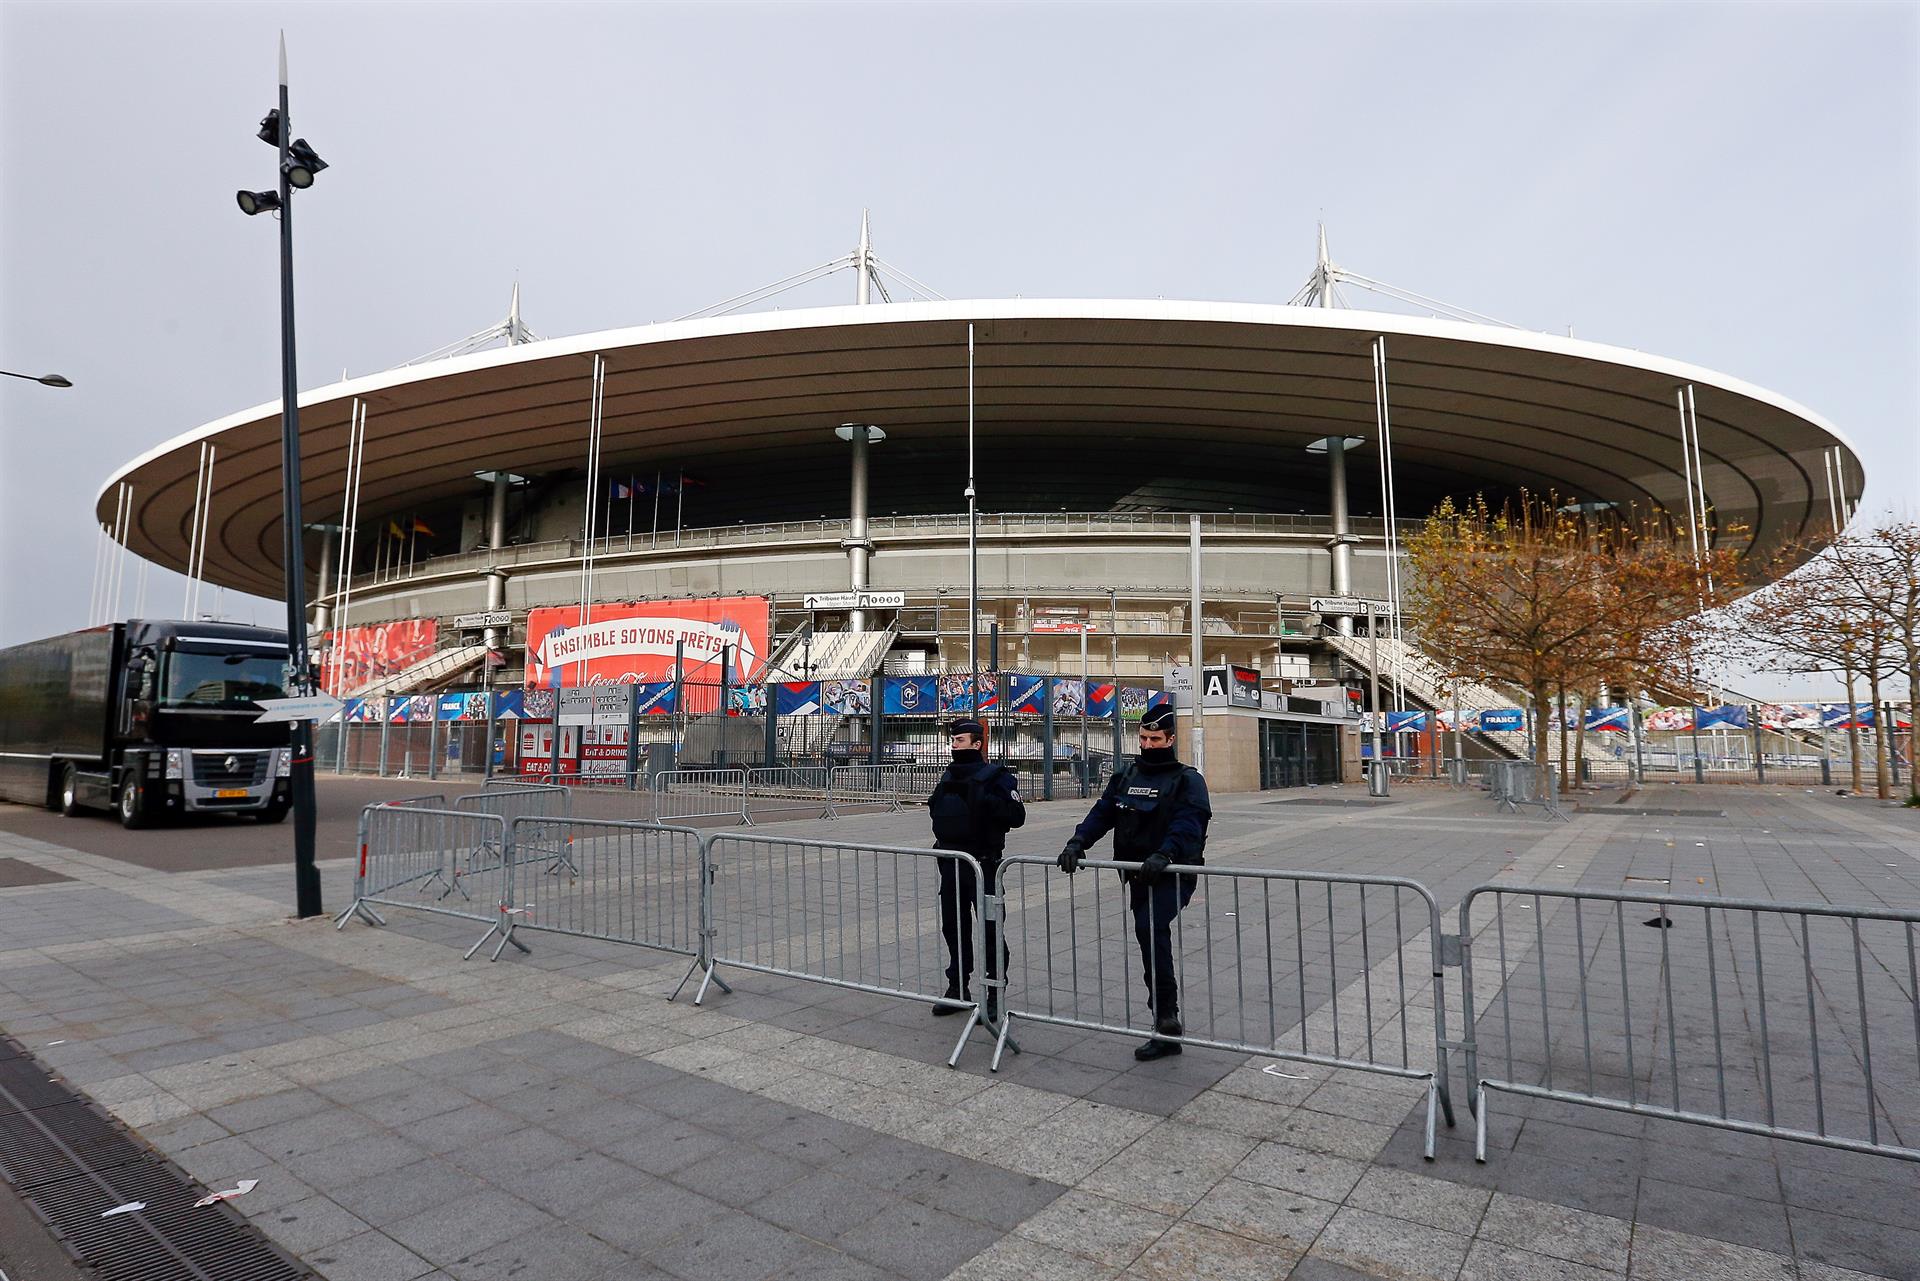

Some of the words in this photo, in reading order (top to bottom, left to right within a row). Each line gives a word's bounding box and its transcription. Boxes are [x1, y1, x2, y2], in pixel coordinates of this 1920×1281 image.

[859, 596, 870, 607] A
[1360, 602, 1368, 614] B
[553, 633, 616, 658] ENSEMBLE
[621, 628, 675, 646] SOYONS
[1206, 675, 1224, 696] A
[1485, 716, 1517, 724] FRANCE
[584, 748, 598, 757] EAT
[605, 749, 628, 757] DRINK
[526, 762, 538, 772] EAT
